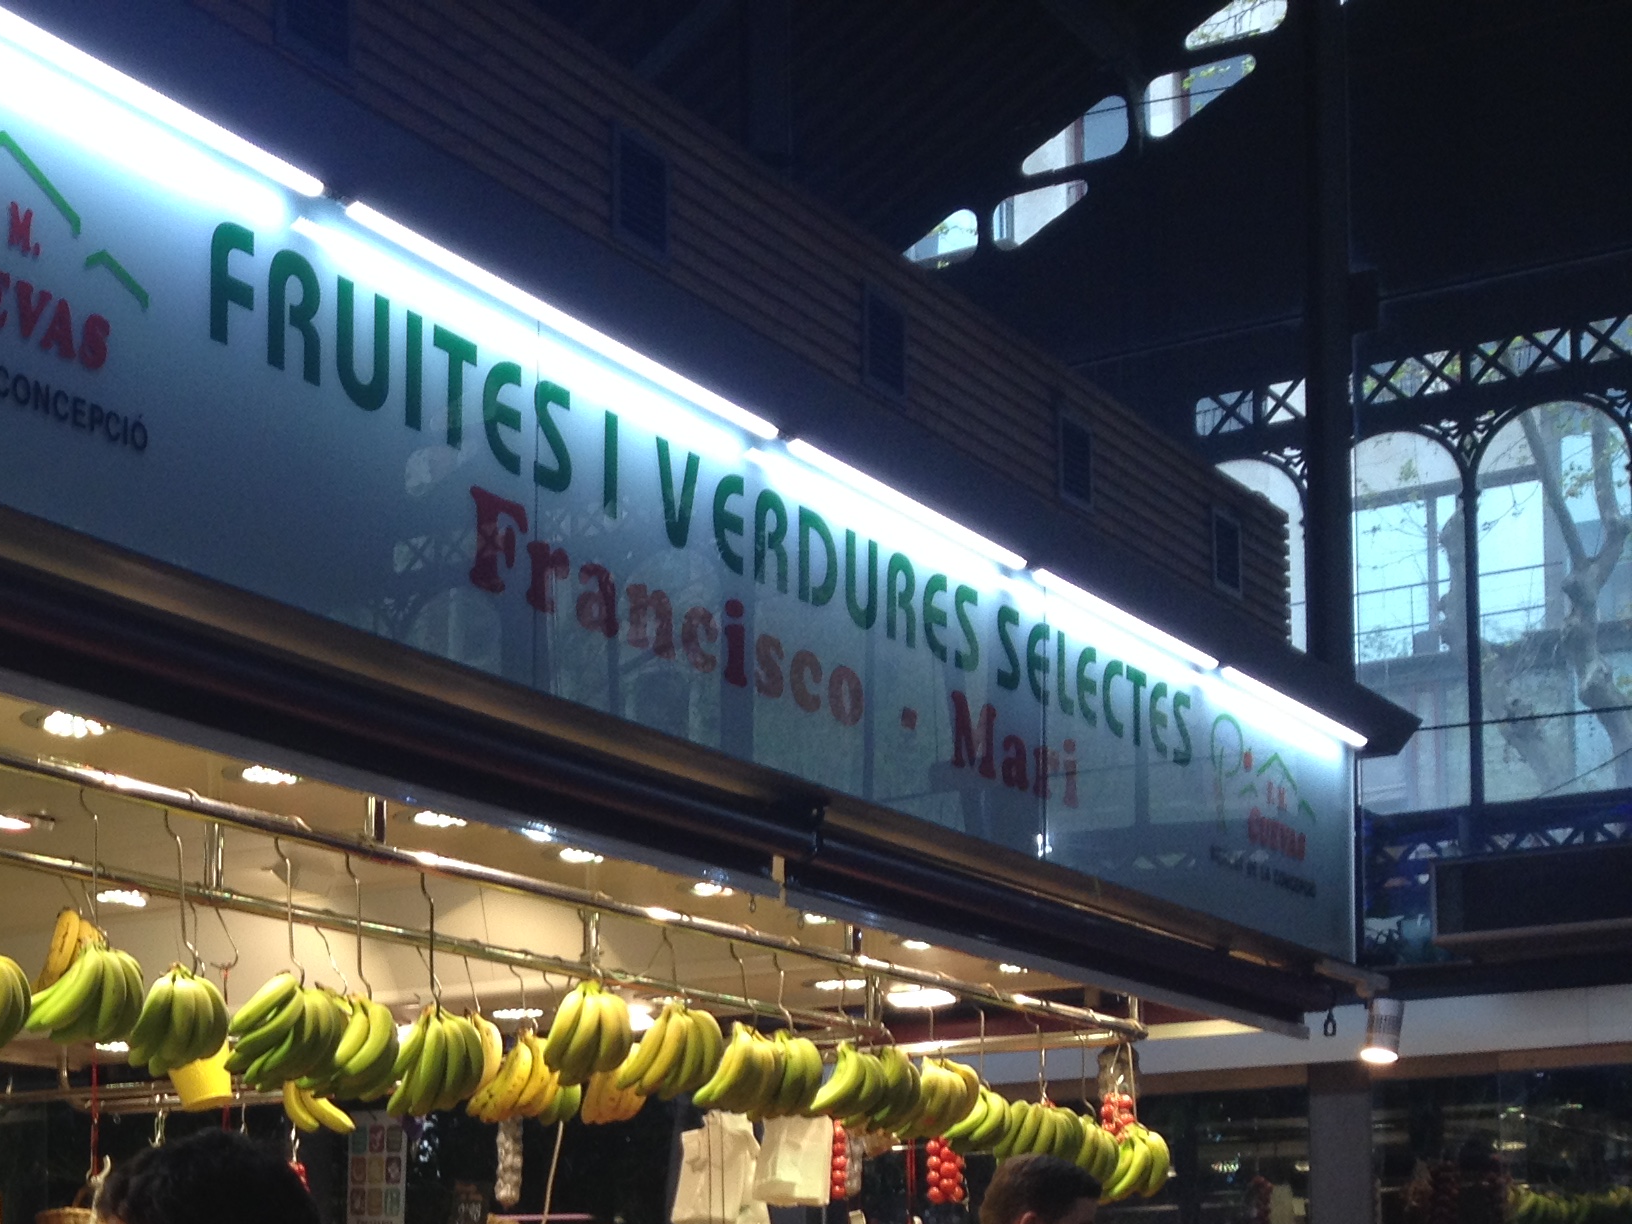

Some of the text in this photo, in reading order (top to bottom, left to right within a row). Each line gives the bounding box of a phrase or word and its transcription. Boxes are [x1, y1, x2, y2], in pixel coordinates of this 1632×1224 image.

[6, 201, 41, 257] M.
[209, 221, 1192, 767] FRUITES I VERDURES SELECTES
[469, 486, 864, 728] Francisco
[950, 690, 1080, 809] Mari
